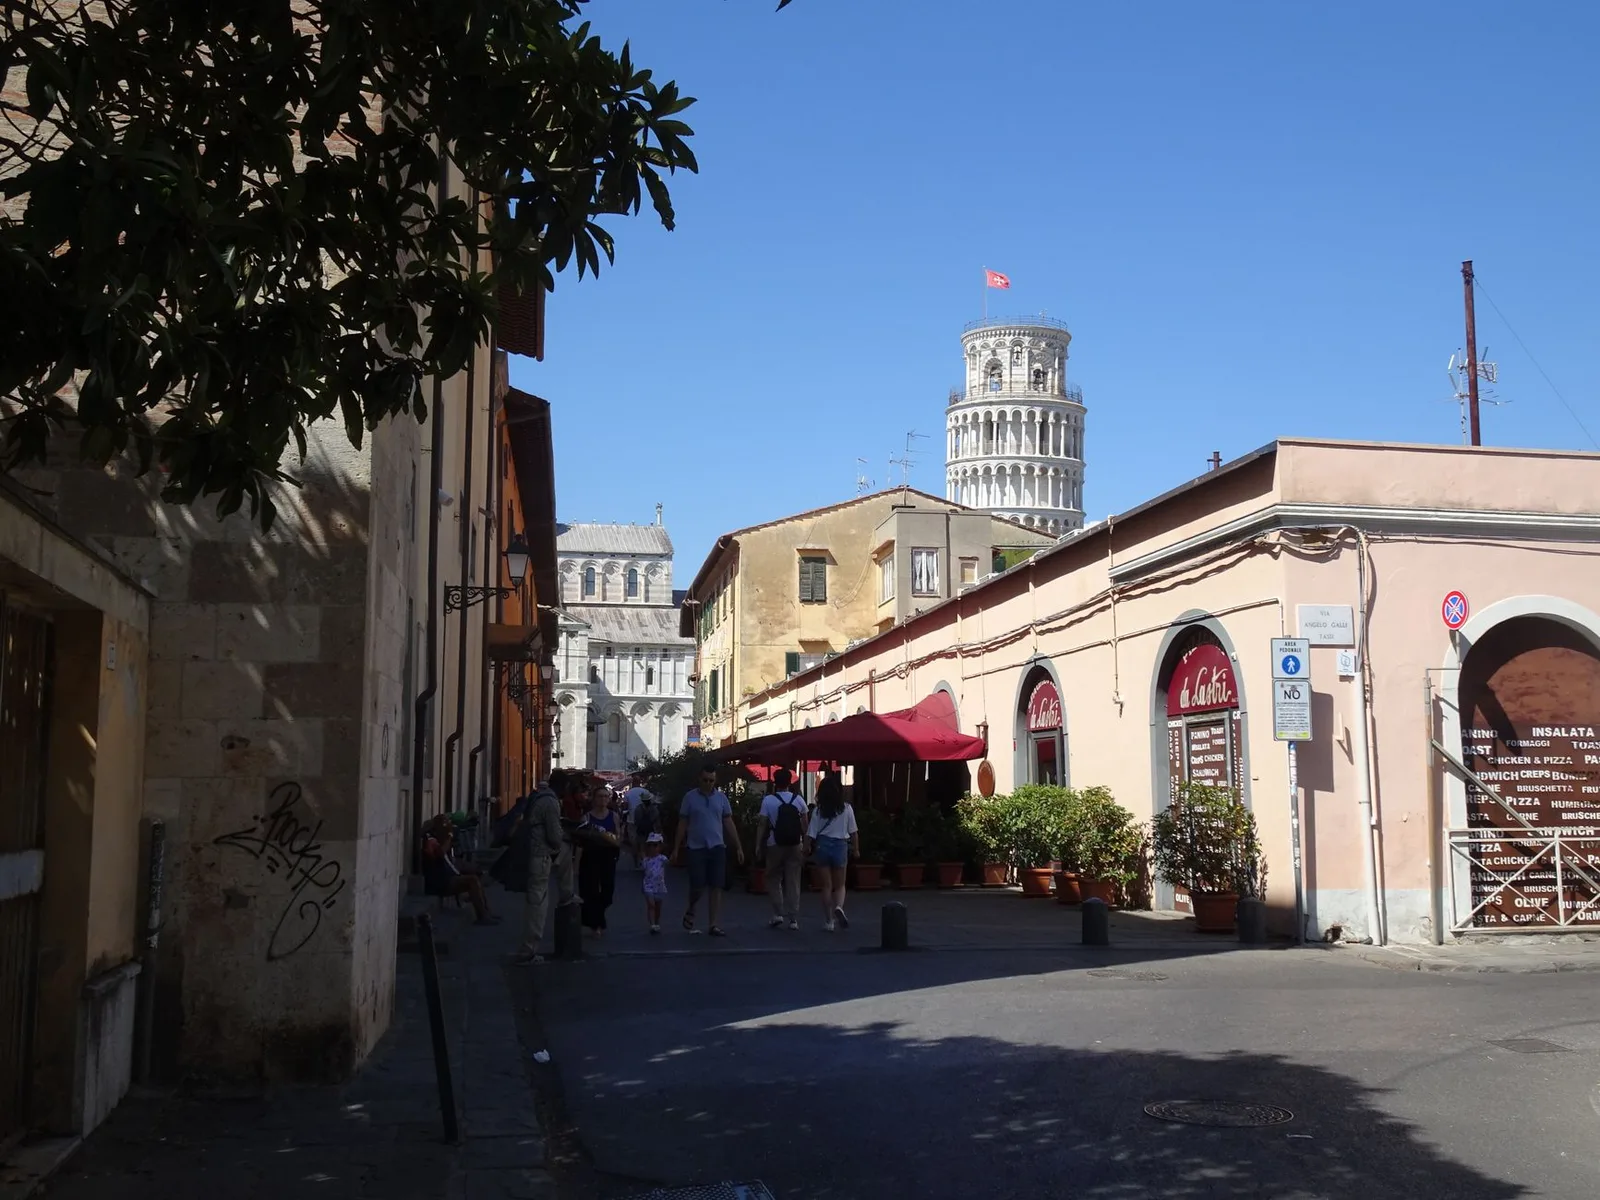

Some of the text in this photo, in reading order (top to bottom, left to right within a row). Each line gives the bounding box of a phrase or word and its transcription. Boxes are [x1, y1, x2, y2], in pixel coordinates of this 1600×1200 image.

[1180, 676, 1190, 708] da
[1283, 689, 1301, 700] NO
[1462, 727, 1595, 739] ANINO INSALATA
[1462, 745, 1492, 755] OAST
[1571, 741, 1600, 750] TOAS
[1487, 756, 1531, 765] CHICKEN
[1533, 756, 1541, 765] &
[1543, 756, 1573, 765] PIZZA
[1520, 770, 1551, 779] CREPS
[1516, 784, 1573, 793] BRUSCHETTA
[1581, 786, 1600, 794] FRU
[1505, 796, 1540, 806] PIZZA
[1514, 897, 1549, 908] OLIVE
